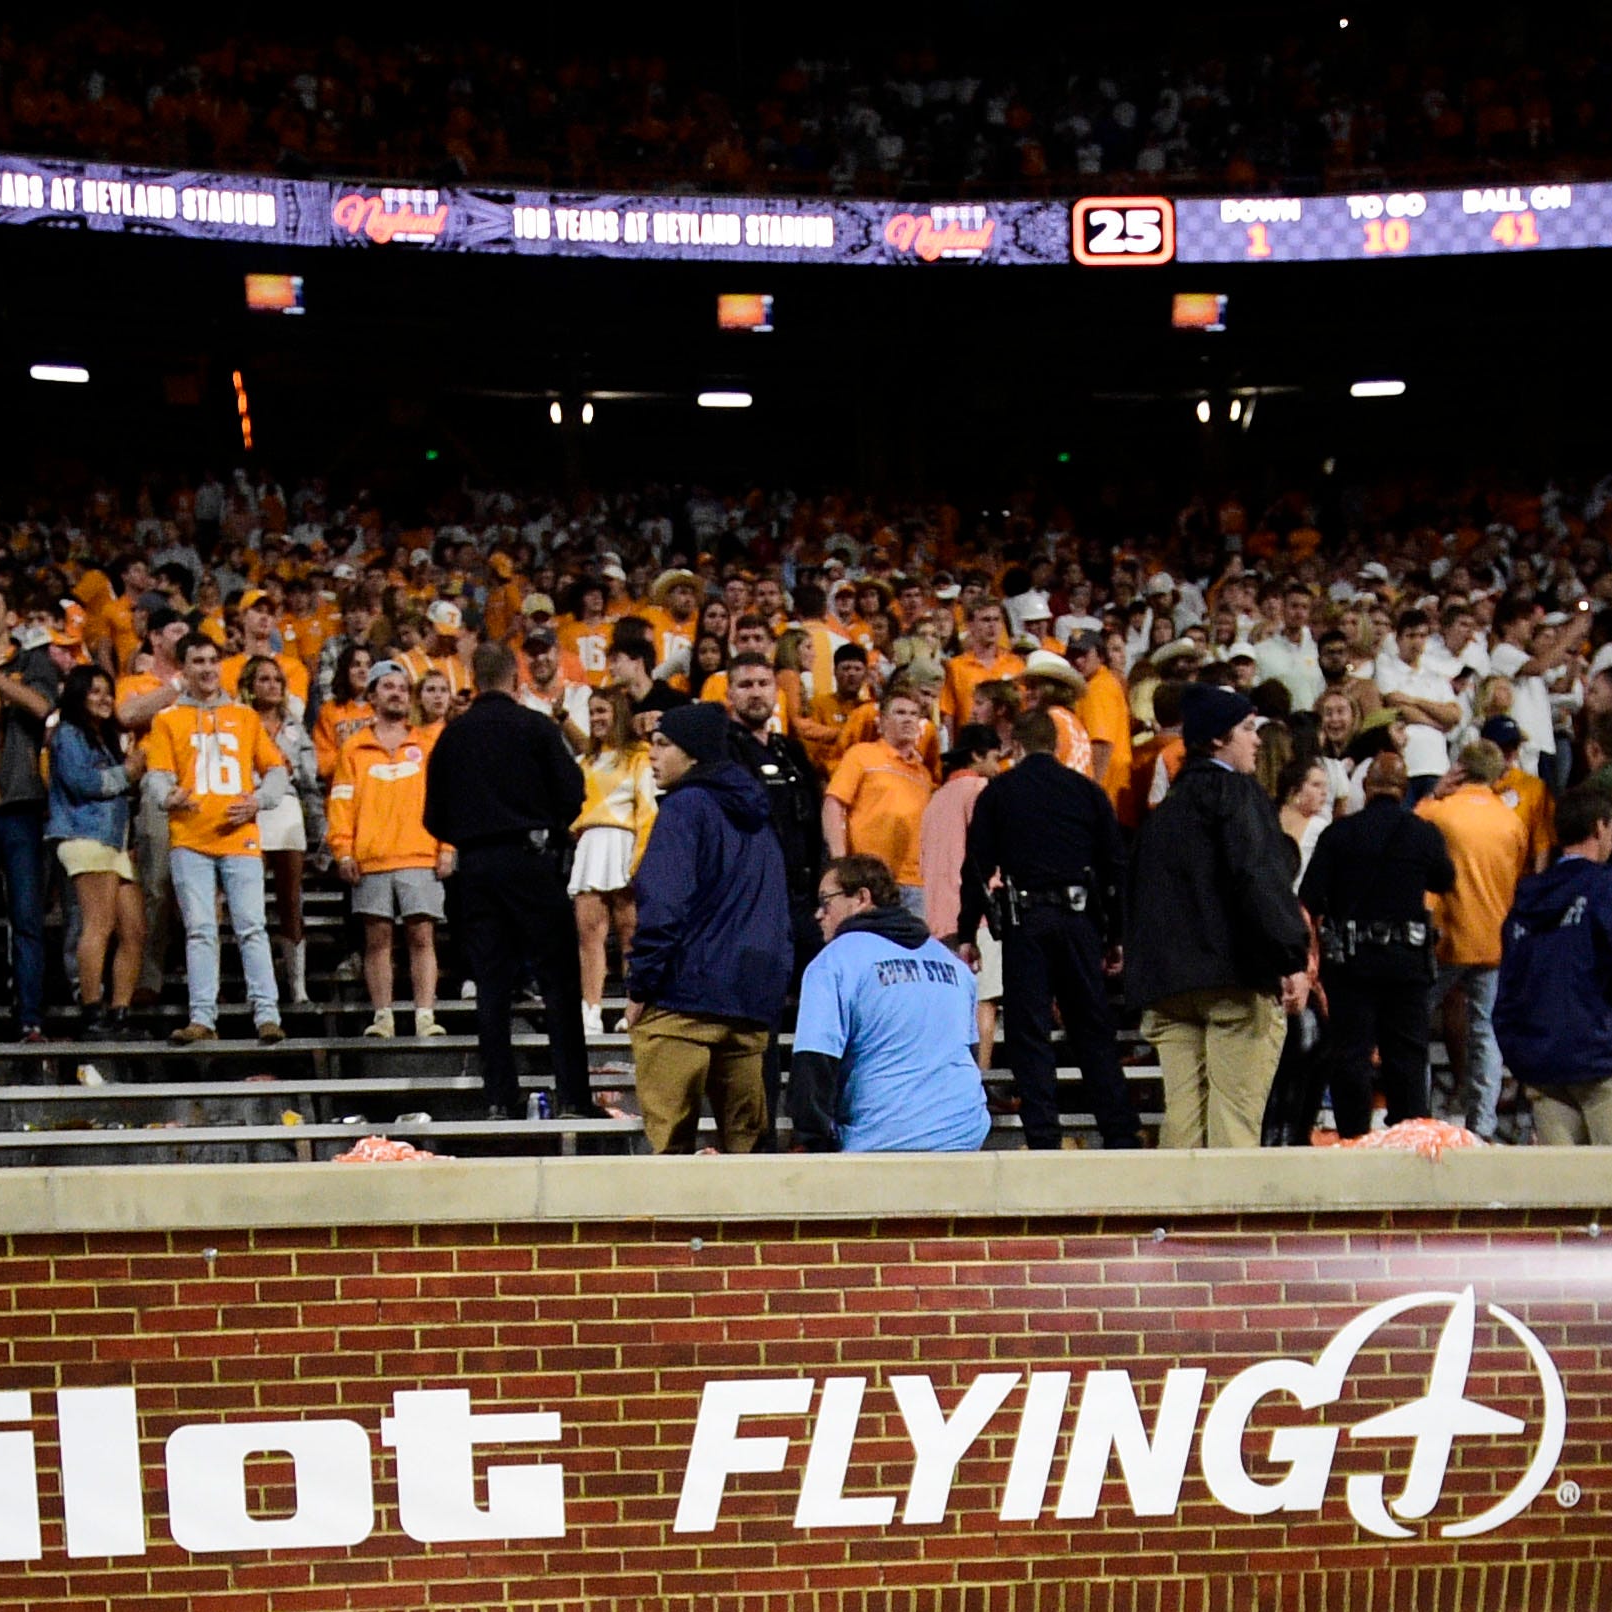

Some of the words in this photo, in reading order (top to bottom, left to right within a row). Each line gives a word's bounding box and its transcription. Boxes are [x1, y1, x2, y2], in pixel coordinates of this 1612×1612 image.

[50, 177, 76, 212] AT
[82, 180, 176, 219] NEYLAND
[1220, 199, 1302, 223] DOWN
[1346, 195, 1384, 220] TO
[1385, 193, 1427, 218] GO
[1462, 188, 1528, 214] BALL
[1530, 185, 1571, 211] ON
[513, 207, 550, 240] 100
[555, 209, 619, 243] YEARS
[624, 211, 649, 243] AT
[1089, 209, 1162, 254] 25
[1246, 223, 1273, 258] 1
[1362, 218, 1412, 255] 10
[1490, 211, 1541, 247] 41
[190, 733, 243, 796] 16
[673, 1359, 1343, 1533] FLYING
